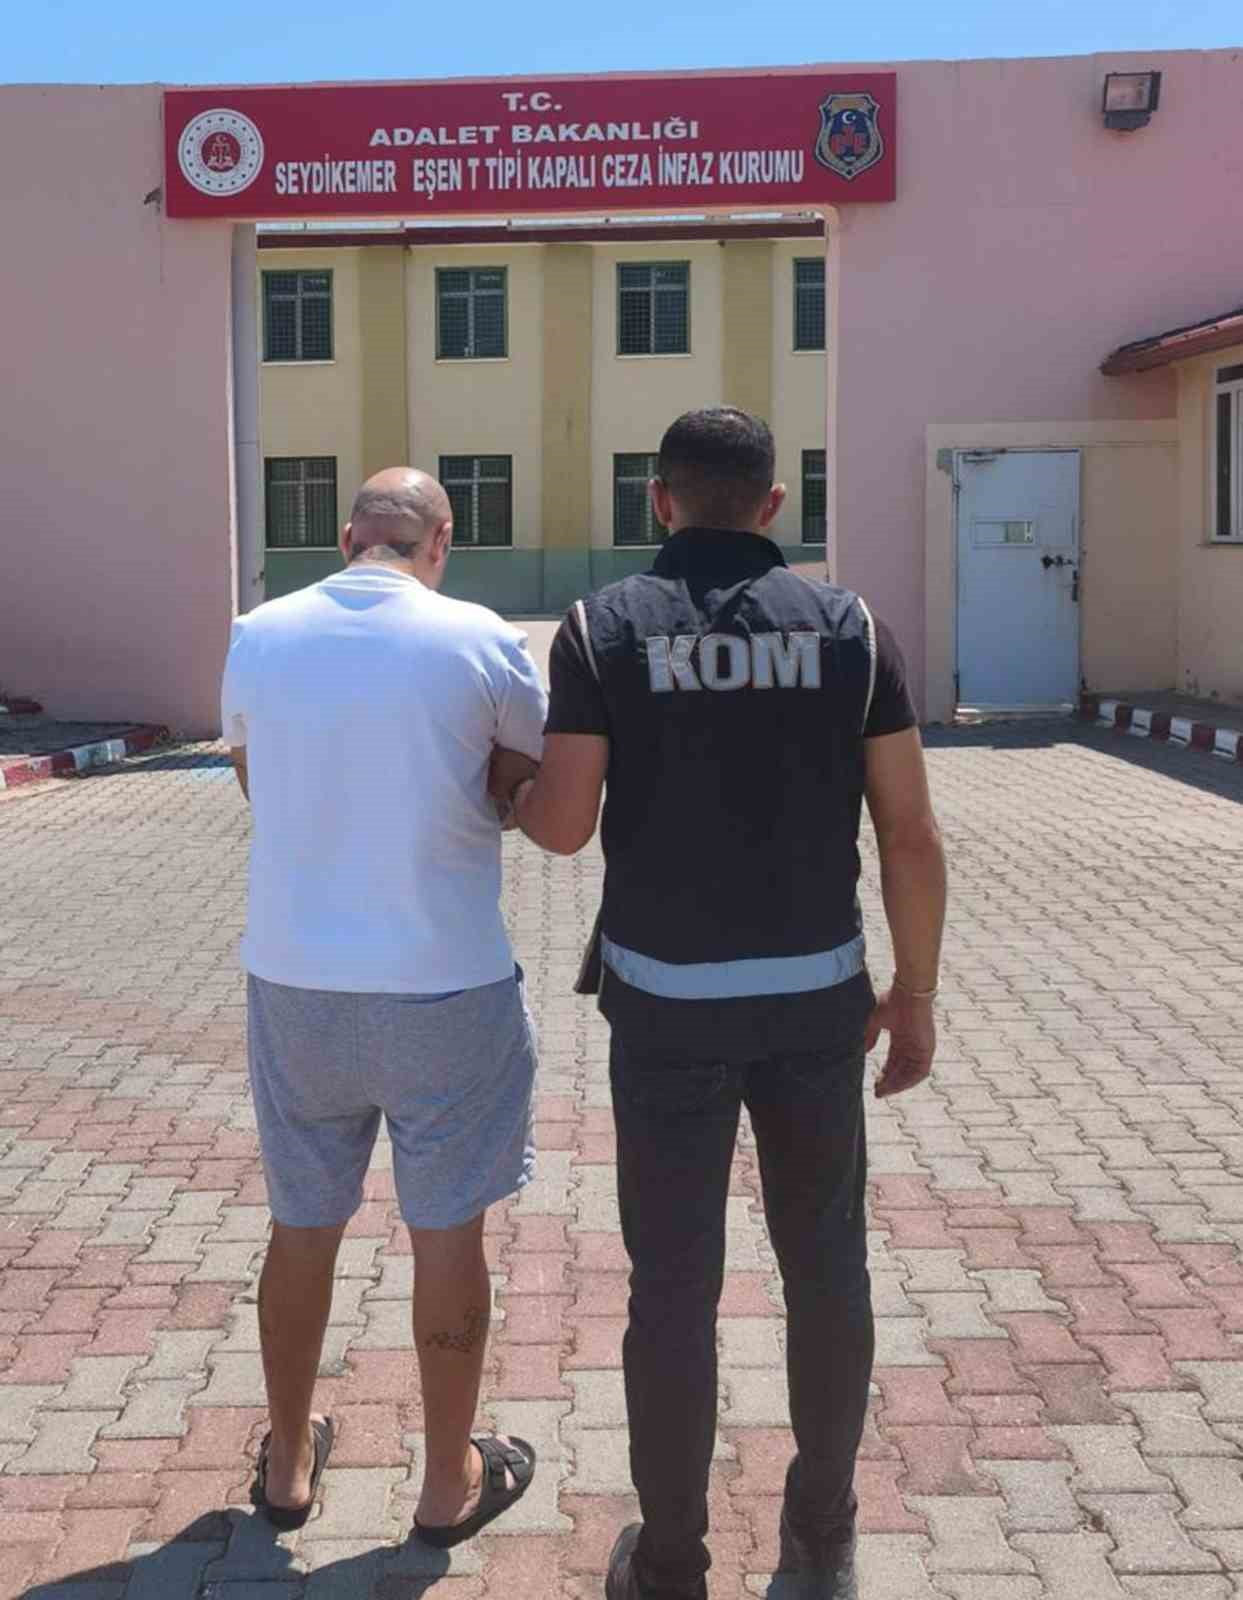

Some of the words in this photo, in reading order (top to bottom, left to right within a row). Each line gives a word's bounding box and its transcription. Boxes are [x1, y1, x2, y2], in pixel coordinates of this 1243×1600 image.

[502, 92, 562, 111] T.C.
[369, 125, 500, 147] ADALET
[511, 117, 699, 142] BAKANLIĞI
[275, 153, 398, 195] SEYDİKEMER
[413, 158, 462, 200] EŞEN
[468, 157, 480, 191] T
[485, 148, 522, 190] TİPİ
[528, 154, 596, 189] KAPALI
[602, 153, 653, 187] CEZA
[658, 145, 714, 185] İNFAZ
[719, 149, 804, 184] KURUMU
[645, 632, 821, 692] KOM
